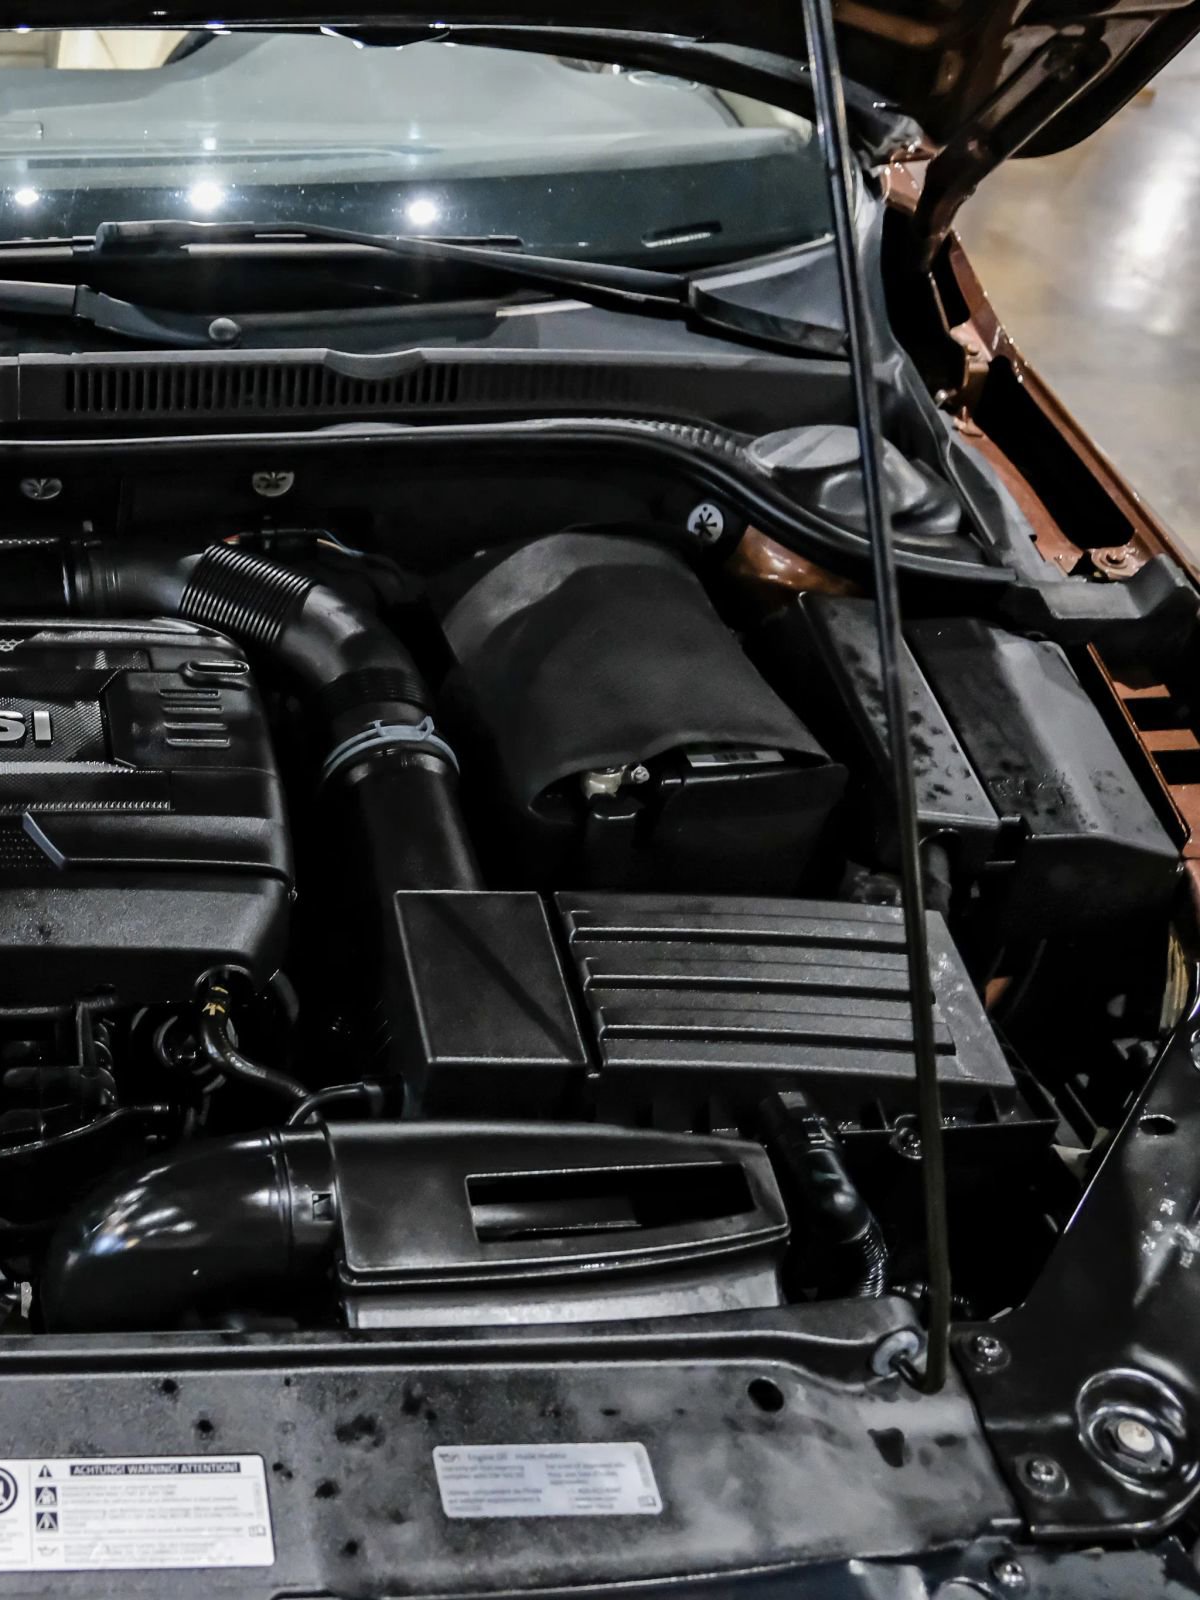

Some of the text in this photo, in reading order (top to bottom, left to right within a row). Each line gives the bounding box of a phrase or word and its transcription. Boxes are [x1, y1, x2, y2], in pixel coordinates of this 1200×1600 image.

[73, 1462, 239, 1476] ACHTUNG! WARNING! ATTENTION!
